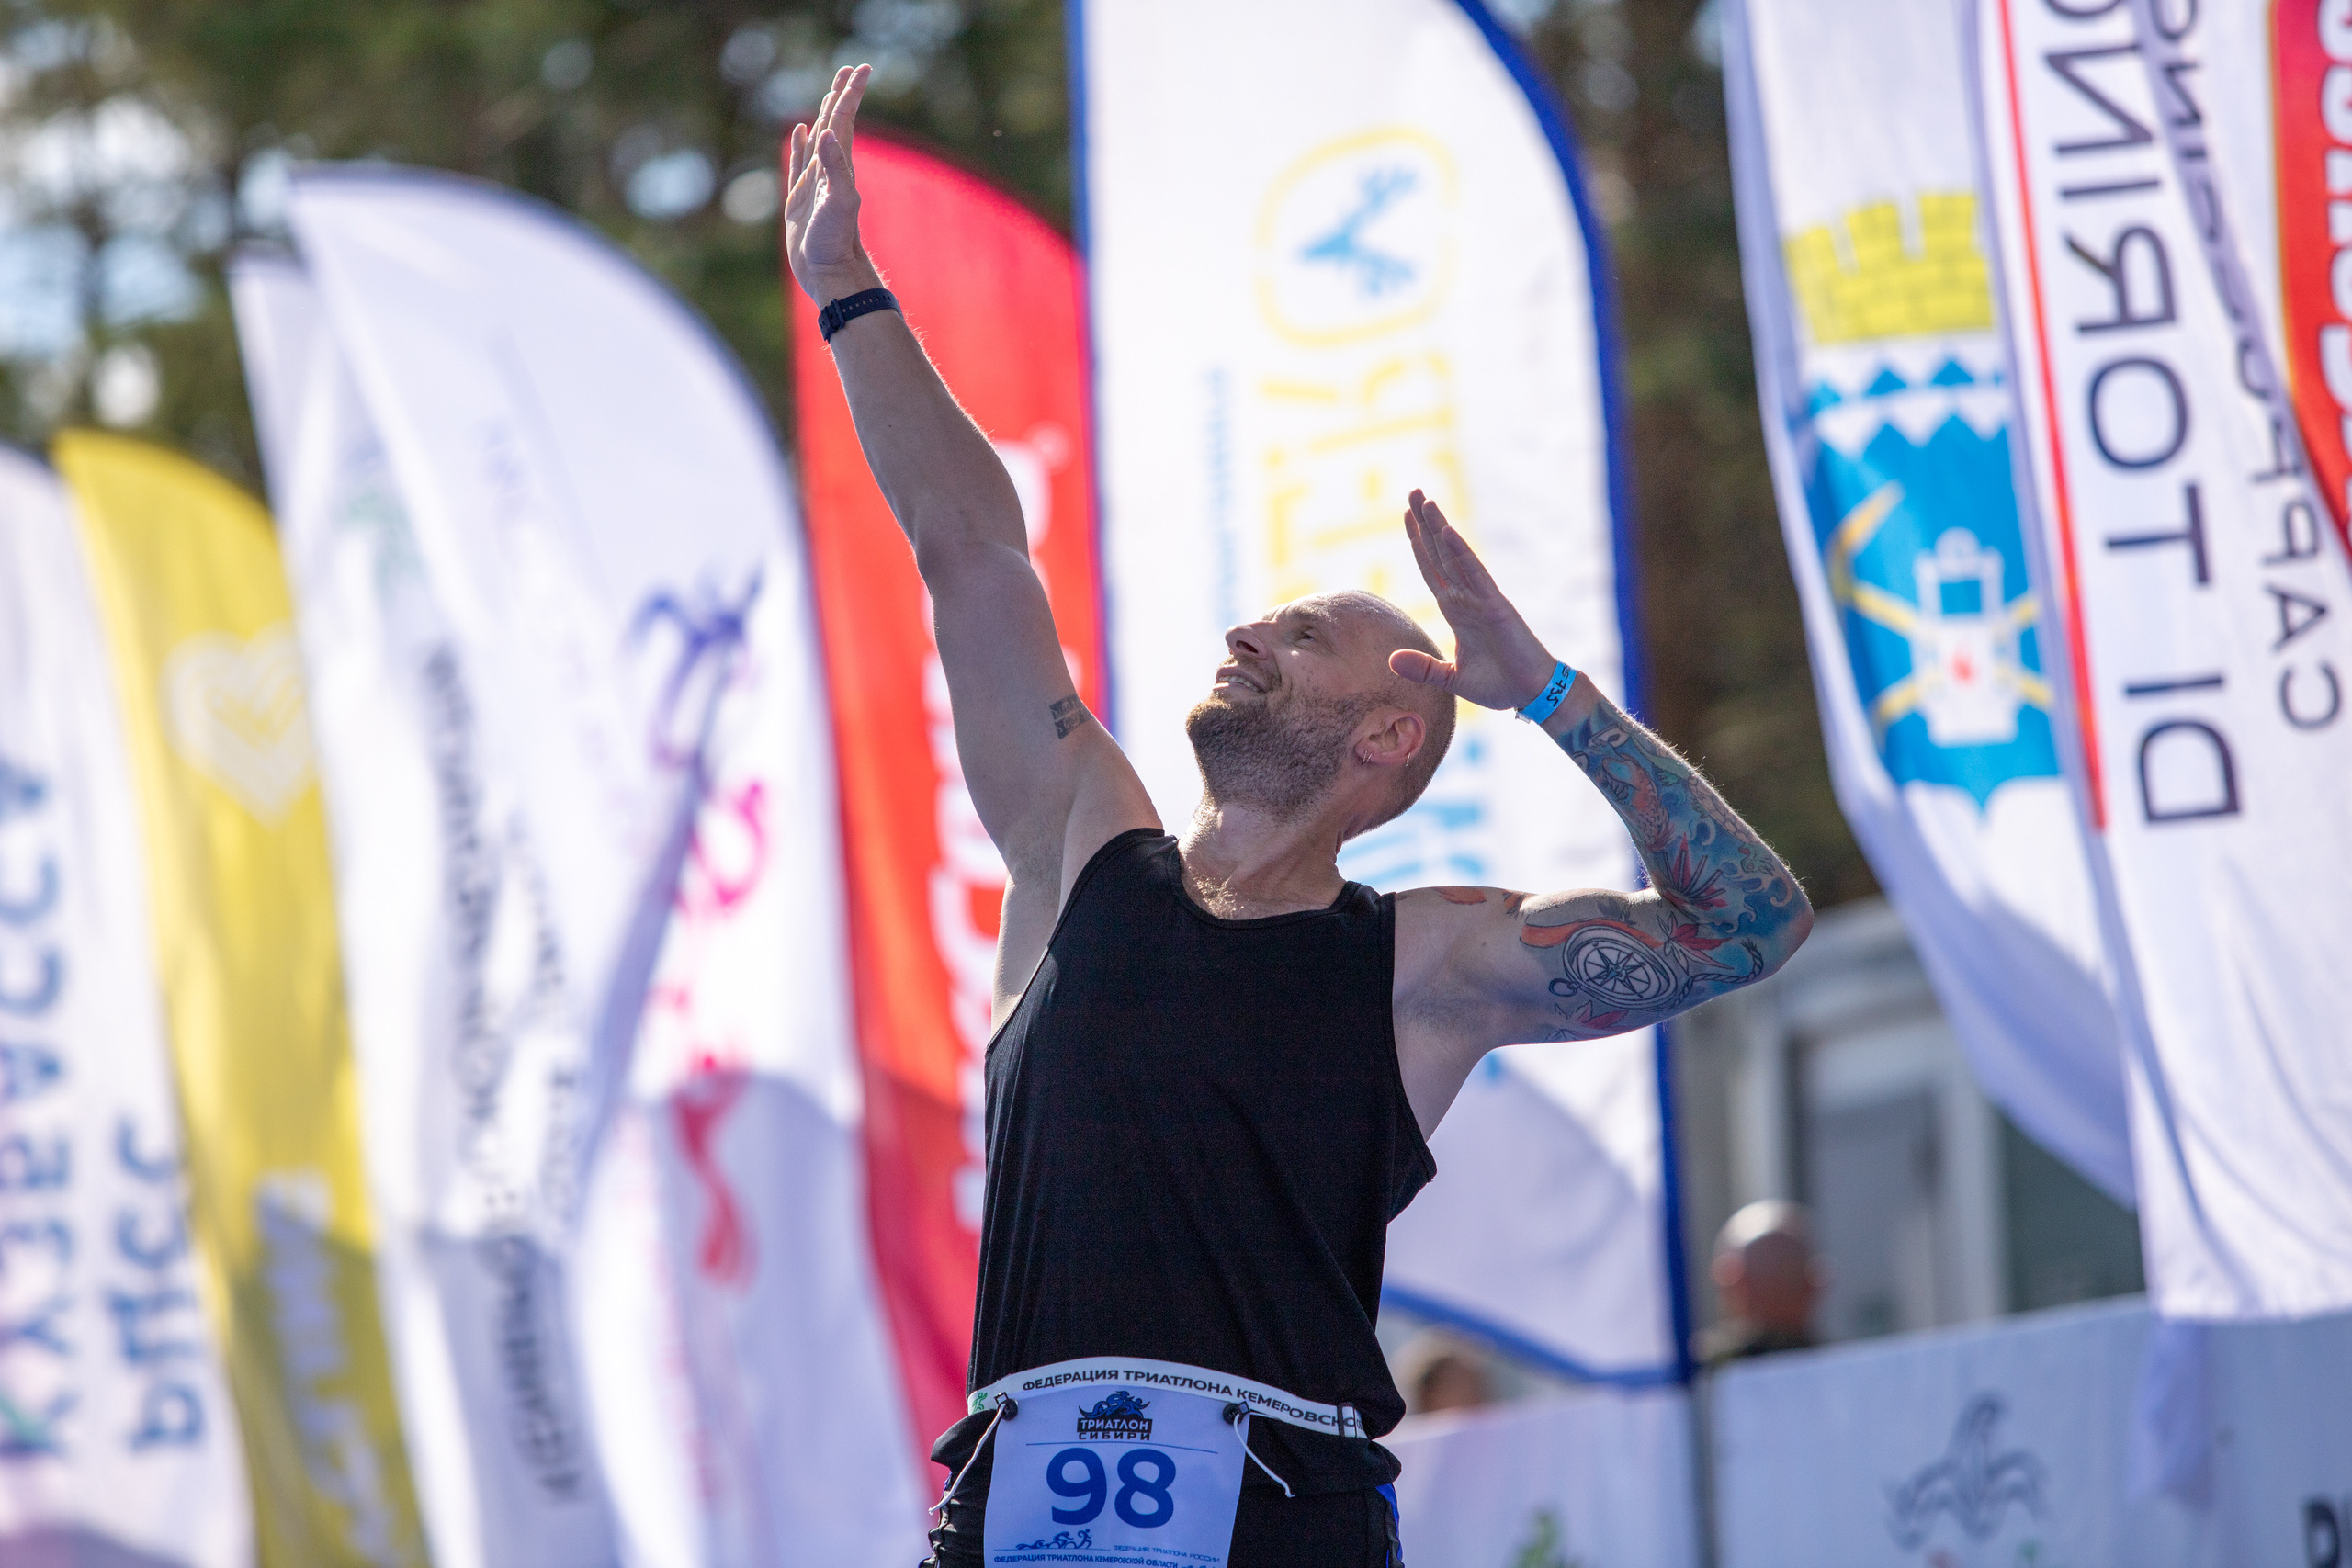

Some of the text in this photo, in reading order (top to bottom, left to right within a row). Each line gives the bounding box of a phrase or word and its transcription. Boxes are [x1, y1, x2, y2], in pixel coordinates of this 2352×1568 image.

[1023, 1370, 1119, 1391] ФЕДЕРАЦИЯ
[1123, 1370, 1233, 1396] ТРИАТЛОНА
[1080, 1418, 1149, 1432] ТРИАТЛОН
[1079, 1432, 1151, 1441] СИБИРИ
[1046, 1447, 1177, 1529] 98
[993, 1554, 1179, 1568] ФЕДЕРАЦИЯ ТРИАТЛОНА КЕМЕРОВСКОЙ ОБЛАСТИ
[1114, 1545, 1221, 1563] ФЕДЕРАЦИЯ ТРИАТЛОНА РОССИИ
